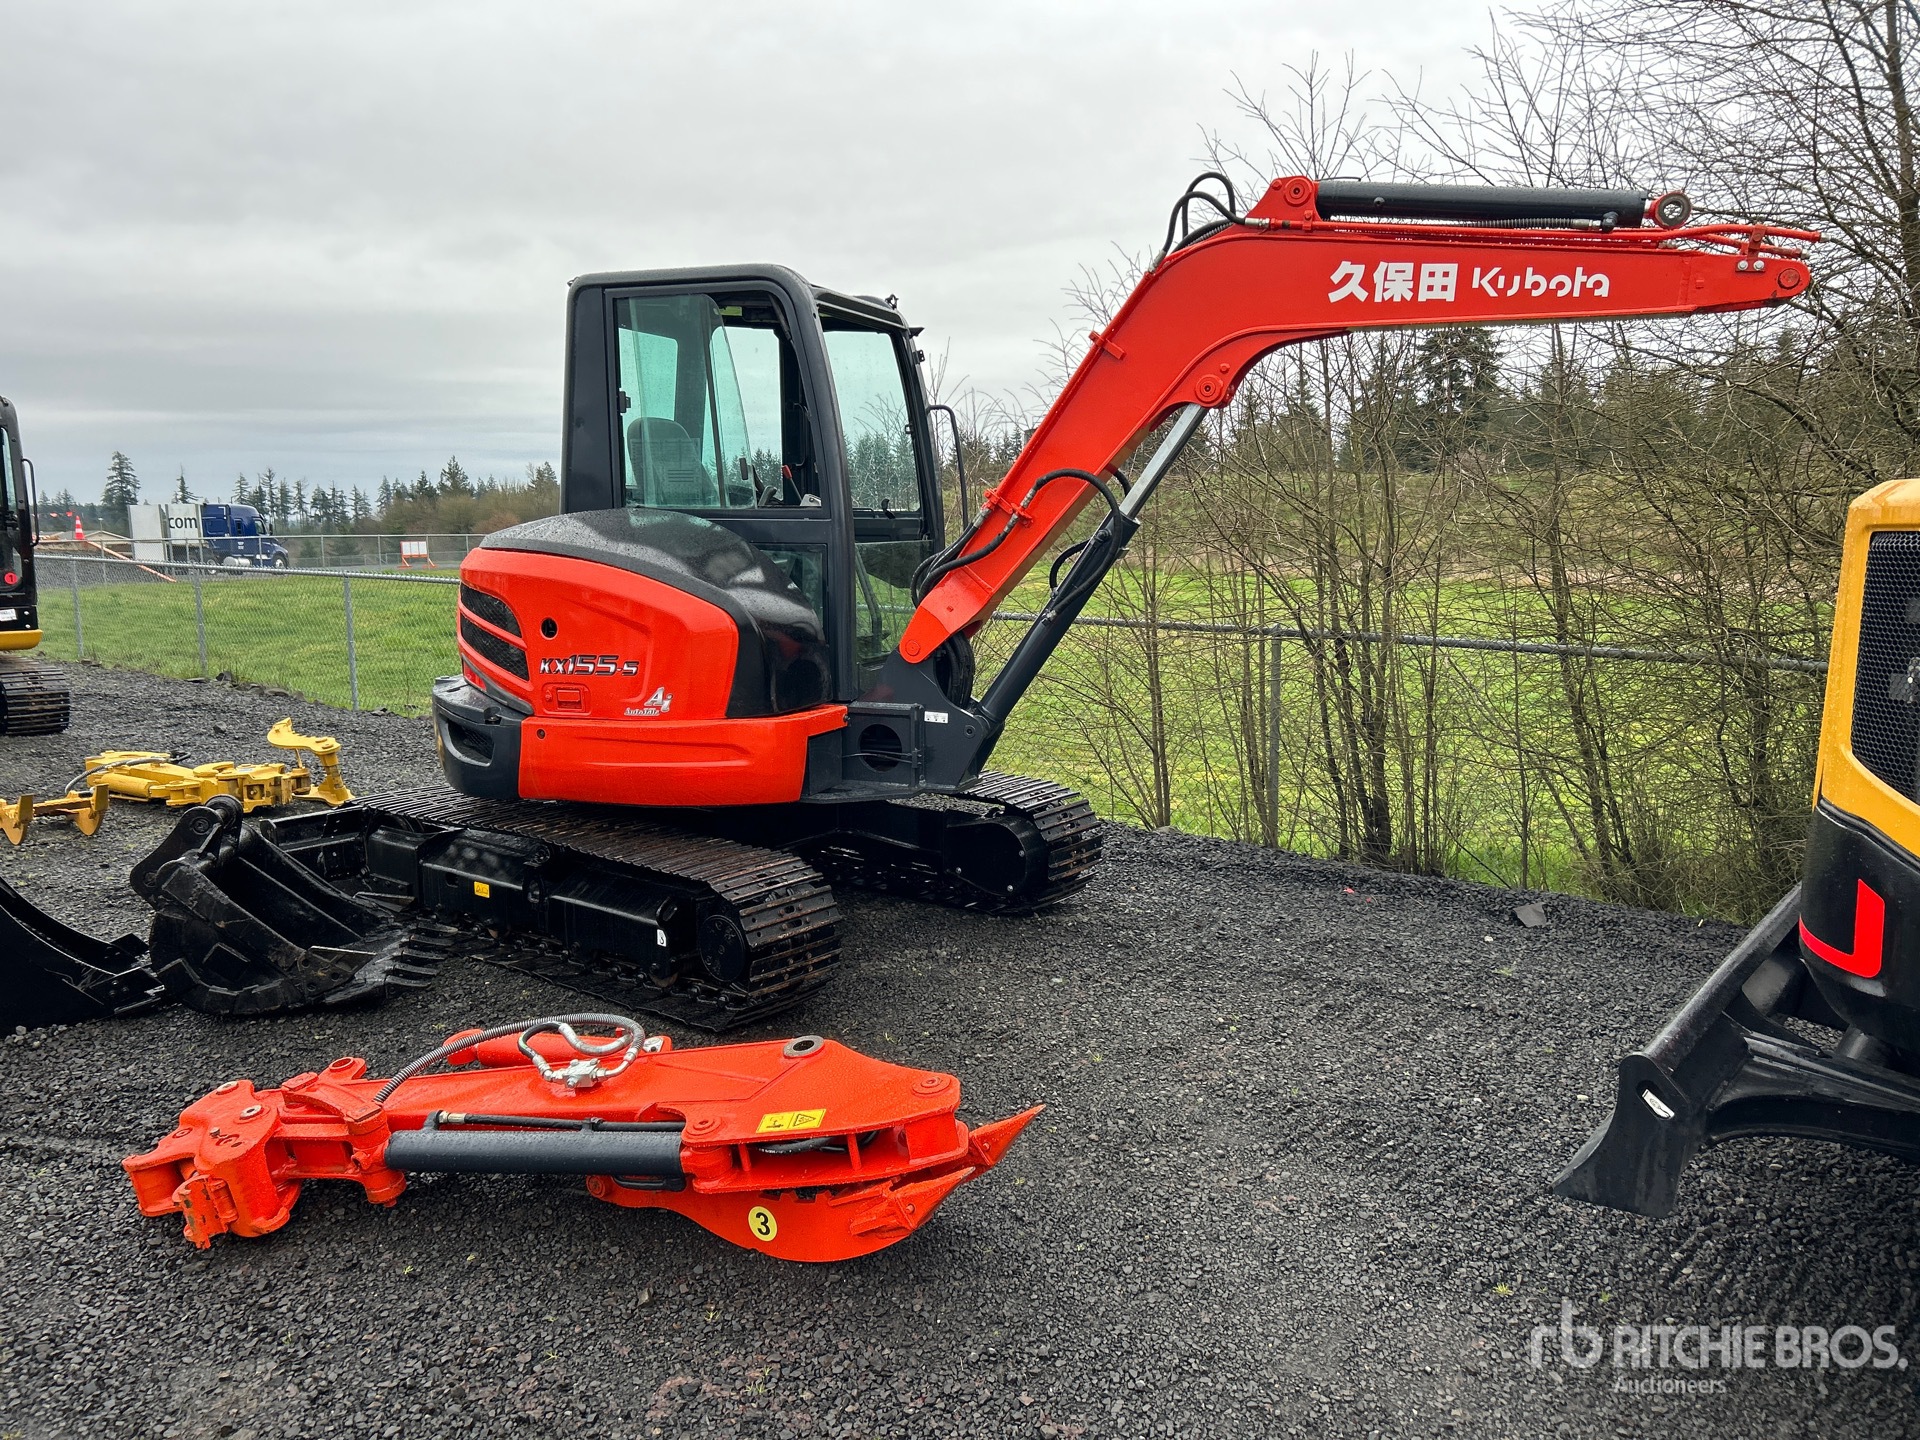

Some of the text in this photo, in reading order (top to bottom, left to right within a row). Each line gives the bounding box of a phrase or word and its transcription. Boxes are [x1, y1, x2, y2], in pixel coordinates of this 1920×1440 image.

[1327, 261, 1458, 302] 久保田
[1471, 266, 1610, 298] Kubota
[755, 1211, 771, 1236] 3
